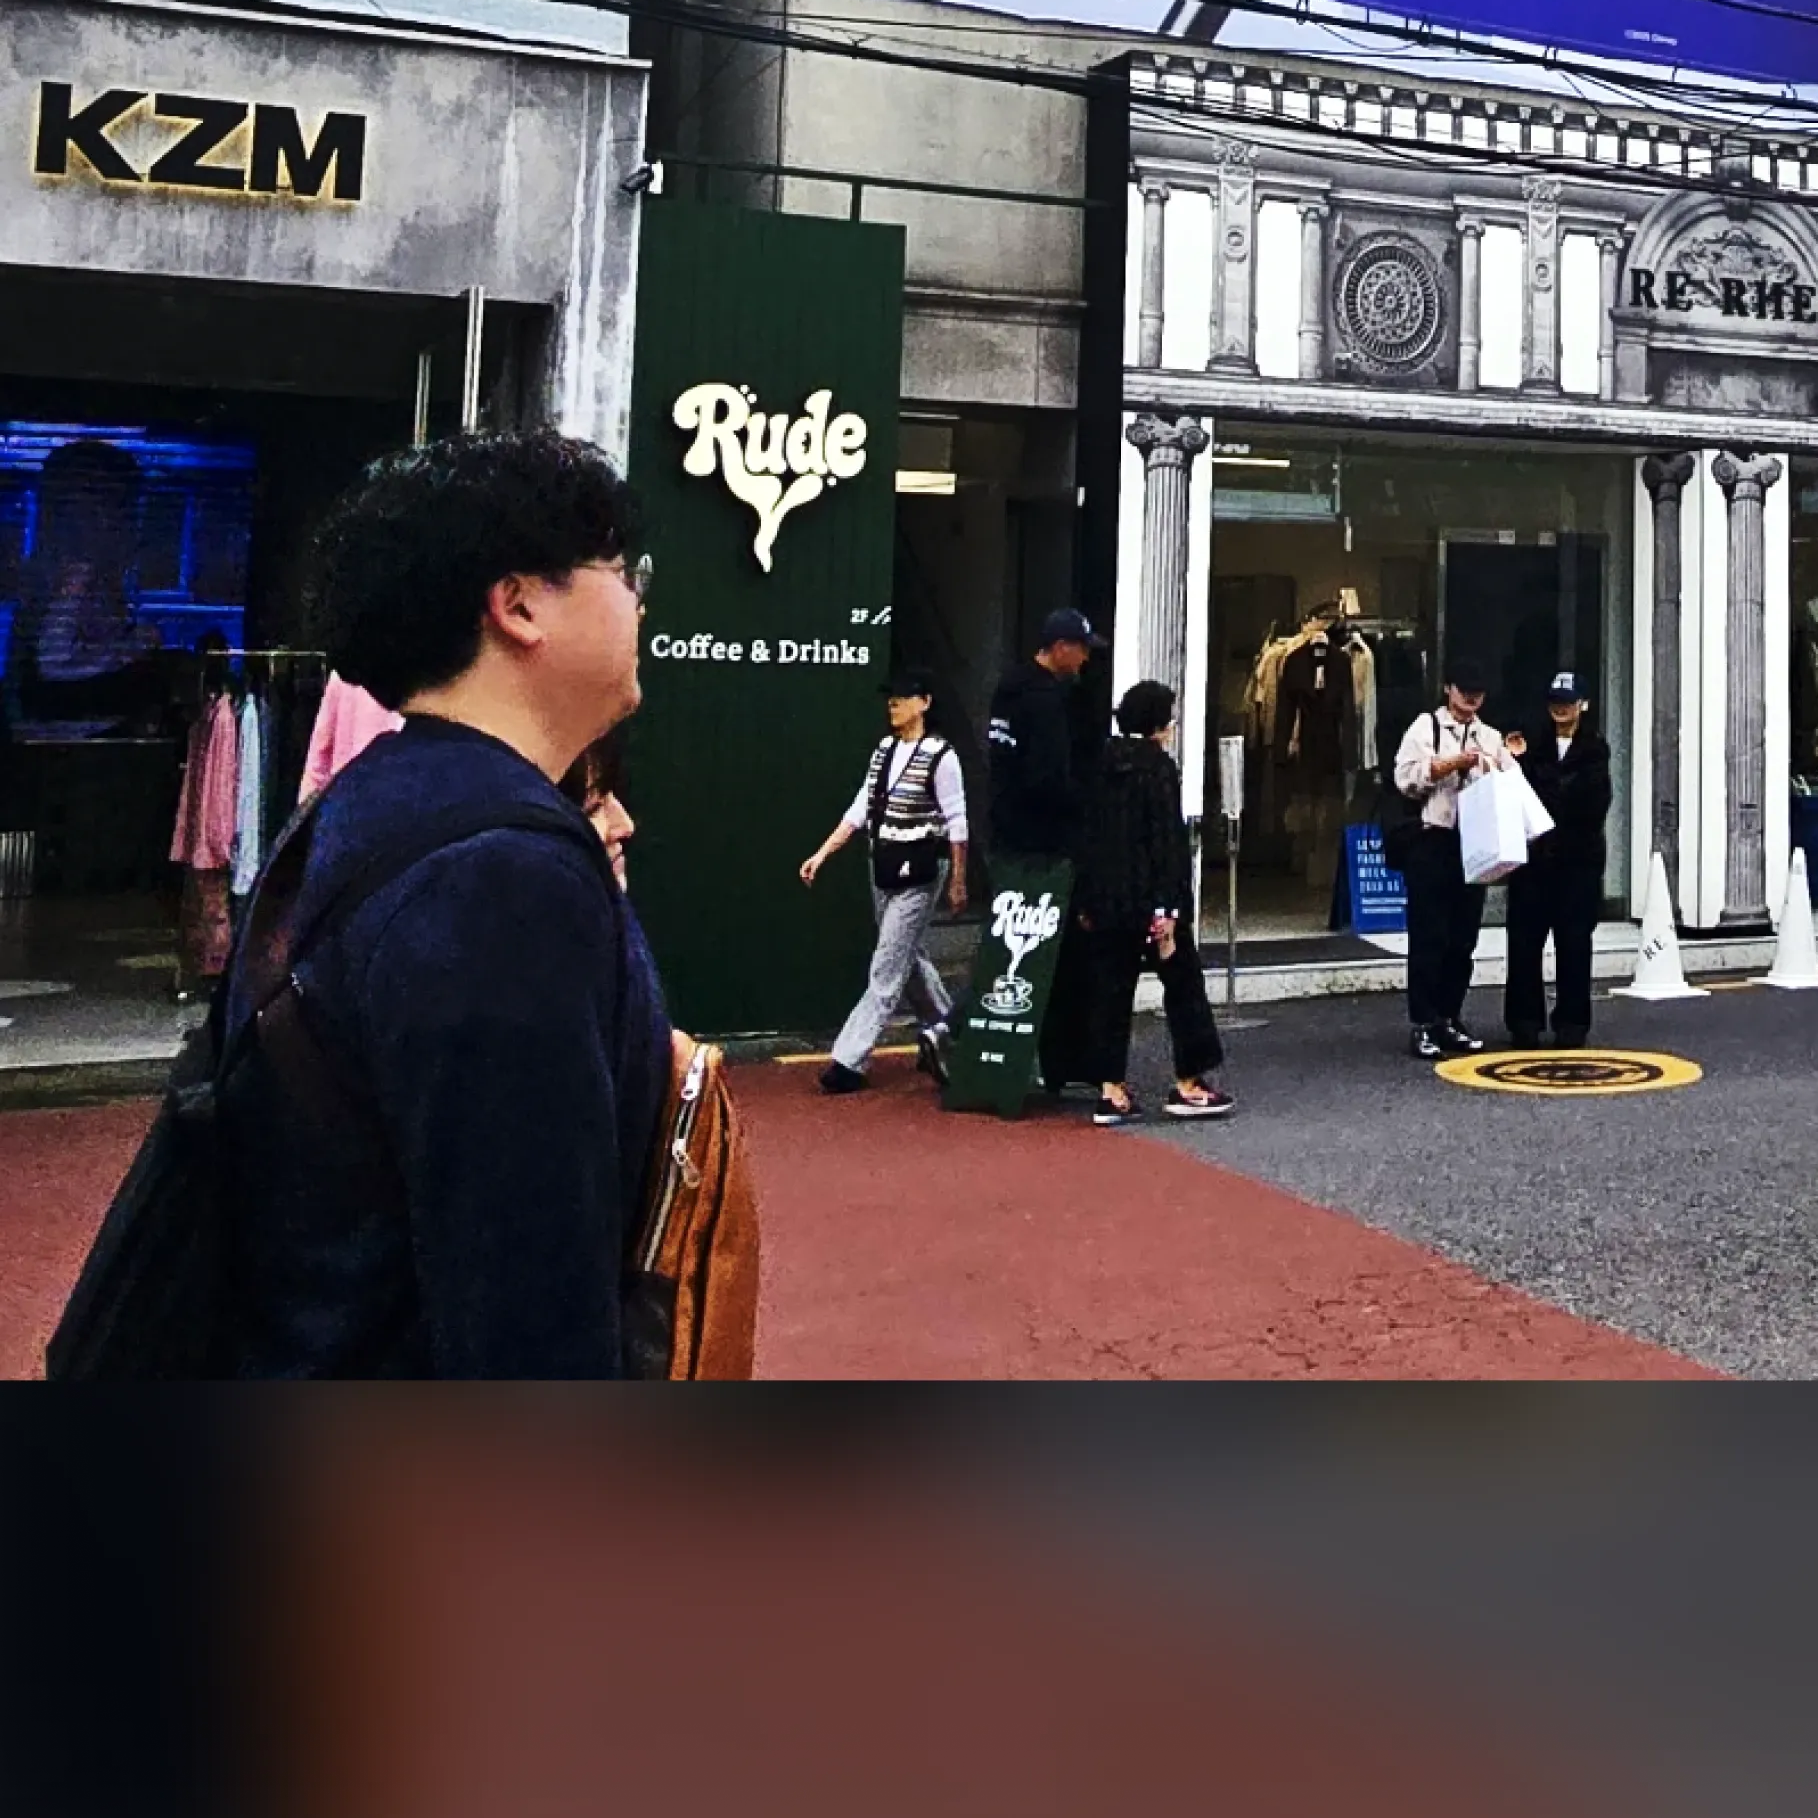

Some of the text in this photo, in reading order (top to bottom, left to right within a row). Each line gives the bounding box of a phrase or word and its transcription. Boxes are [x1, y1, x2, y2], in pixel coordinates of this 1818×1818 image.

[34, 81, 366, 202] KZM
[672, 381, 868, 512] Rude
[650, 632, 870, 666] Coffee & Drinks
[990, 890, 1061, 950] Rude
